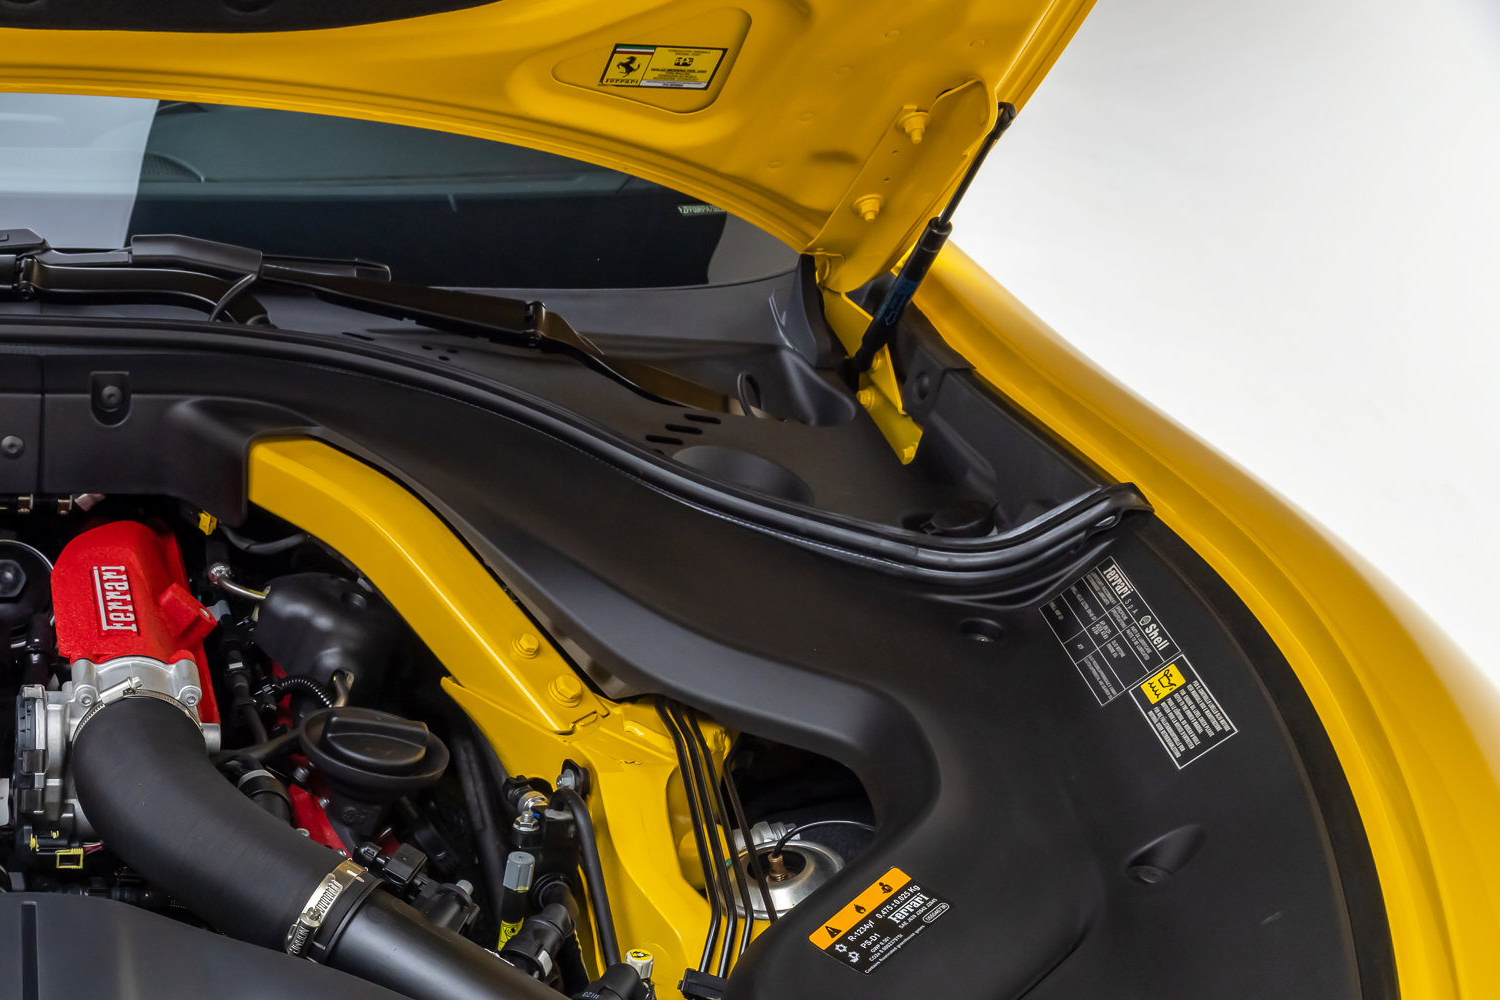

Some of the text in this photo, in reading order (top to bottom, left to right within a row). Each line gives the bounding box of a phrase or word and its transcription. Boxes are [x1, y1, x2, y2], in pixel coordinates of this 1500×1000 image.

[93, 566, 138, 632] Ferrari
[1103, 564, 1134, 599] Ferrari
[1145, 623, 1170, 651] Shell
[848, 919, 875, 942] R-1234yf
[908, 885, 921, 894] Kg
[888, 892, 929, 924] Ferrari
[860, 933, 881, 948] PS-D1
